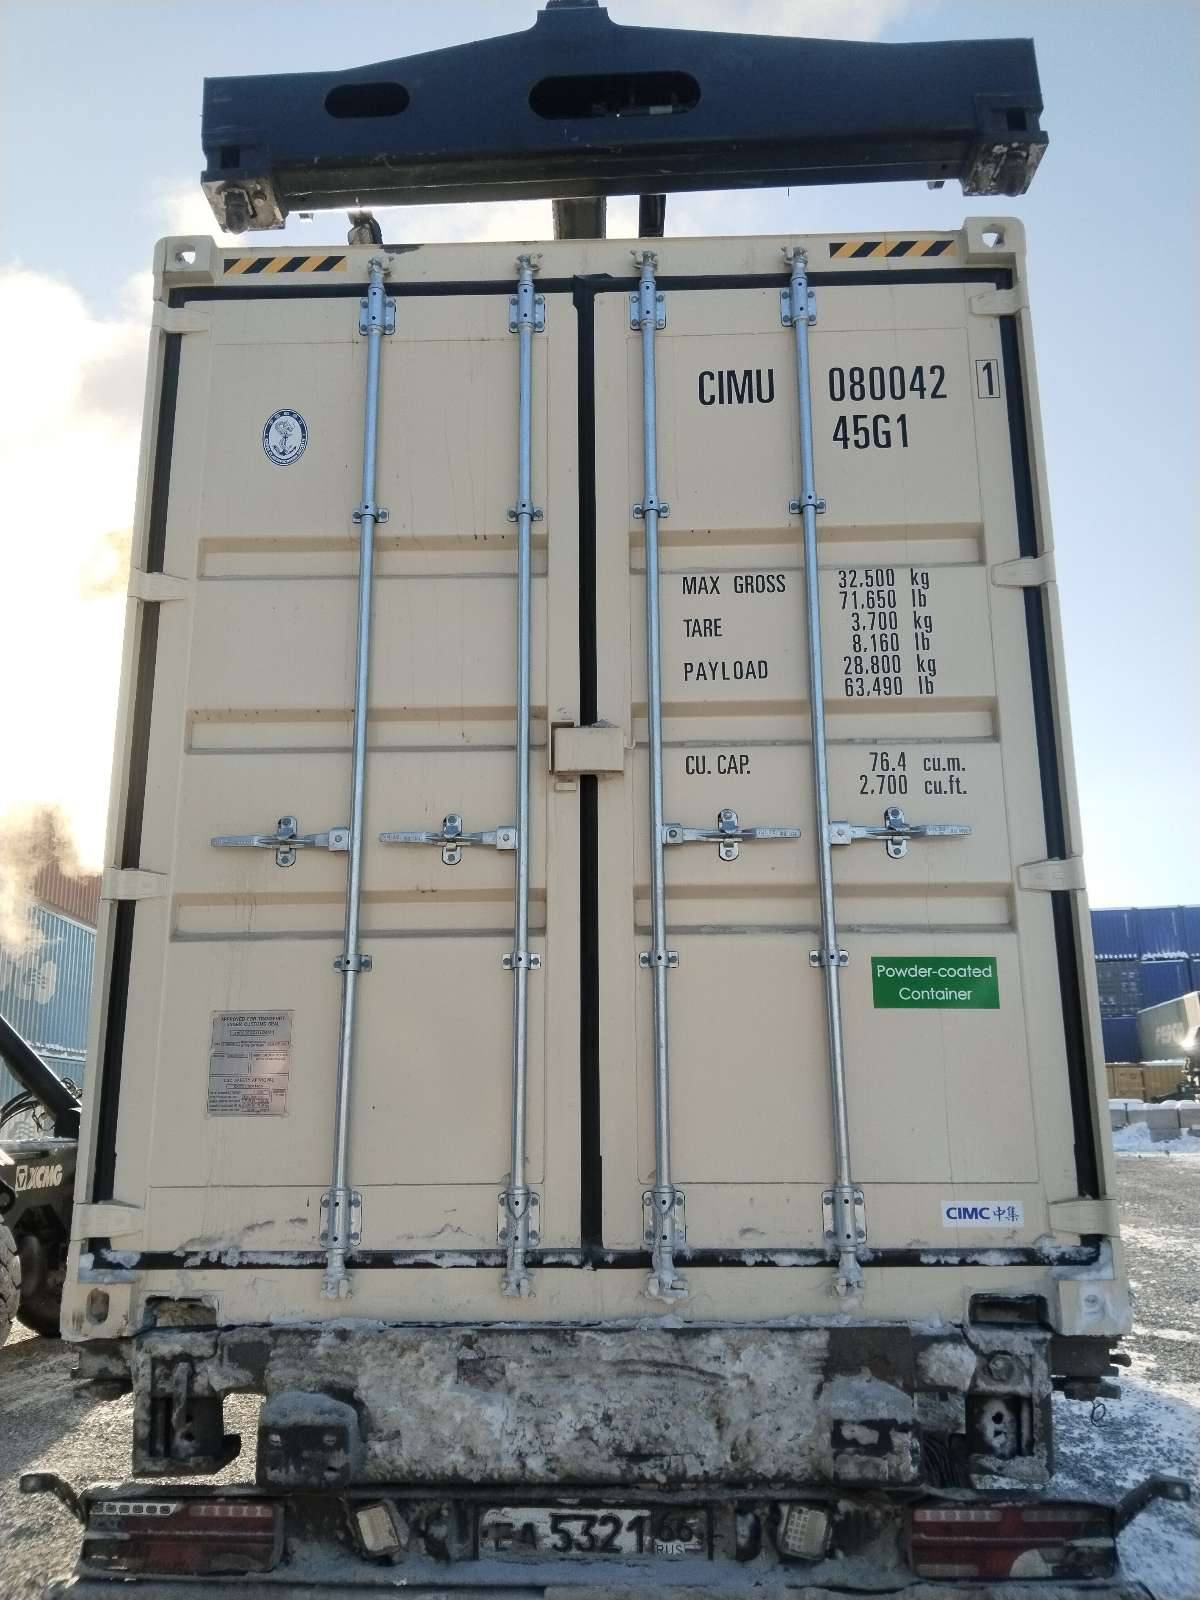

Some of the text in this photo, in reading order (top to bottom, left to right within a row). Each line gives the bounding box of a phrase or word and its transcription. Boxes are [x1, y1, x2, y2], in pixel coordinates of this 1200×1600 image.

[699, 362, 994, 405] CIMU 080042 1
[832, 414, 908, 449] 45G1
[683, 568, 929, 594] MAX GROSS 32,500 kg
[840, 589, 926, 610] 71,650 lb
[683, 611, 932, 637] TARE 3,700 kg
[853, 632, 930, 652] 8,160 lb
[684, 660, 768, 681] PAYLOAD
[917, 654, 936, 676] kg
[845, 676, 933, 696] 63,490 lb
[686, 752, 965, 774] CU. CAP. 76.4 cu.m.
[860, 775, 967, 794] 2,700 cu.ft.
[877, 965, 992, 977] Powder-coated
[899, 987, 972, 1000] Container
[946, 1207, 990, 1219] CIMC
